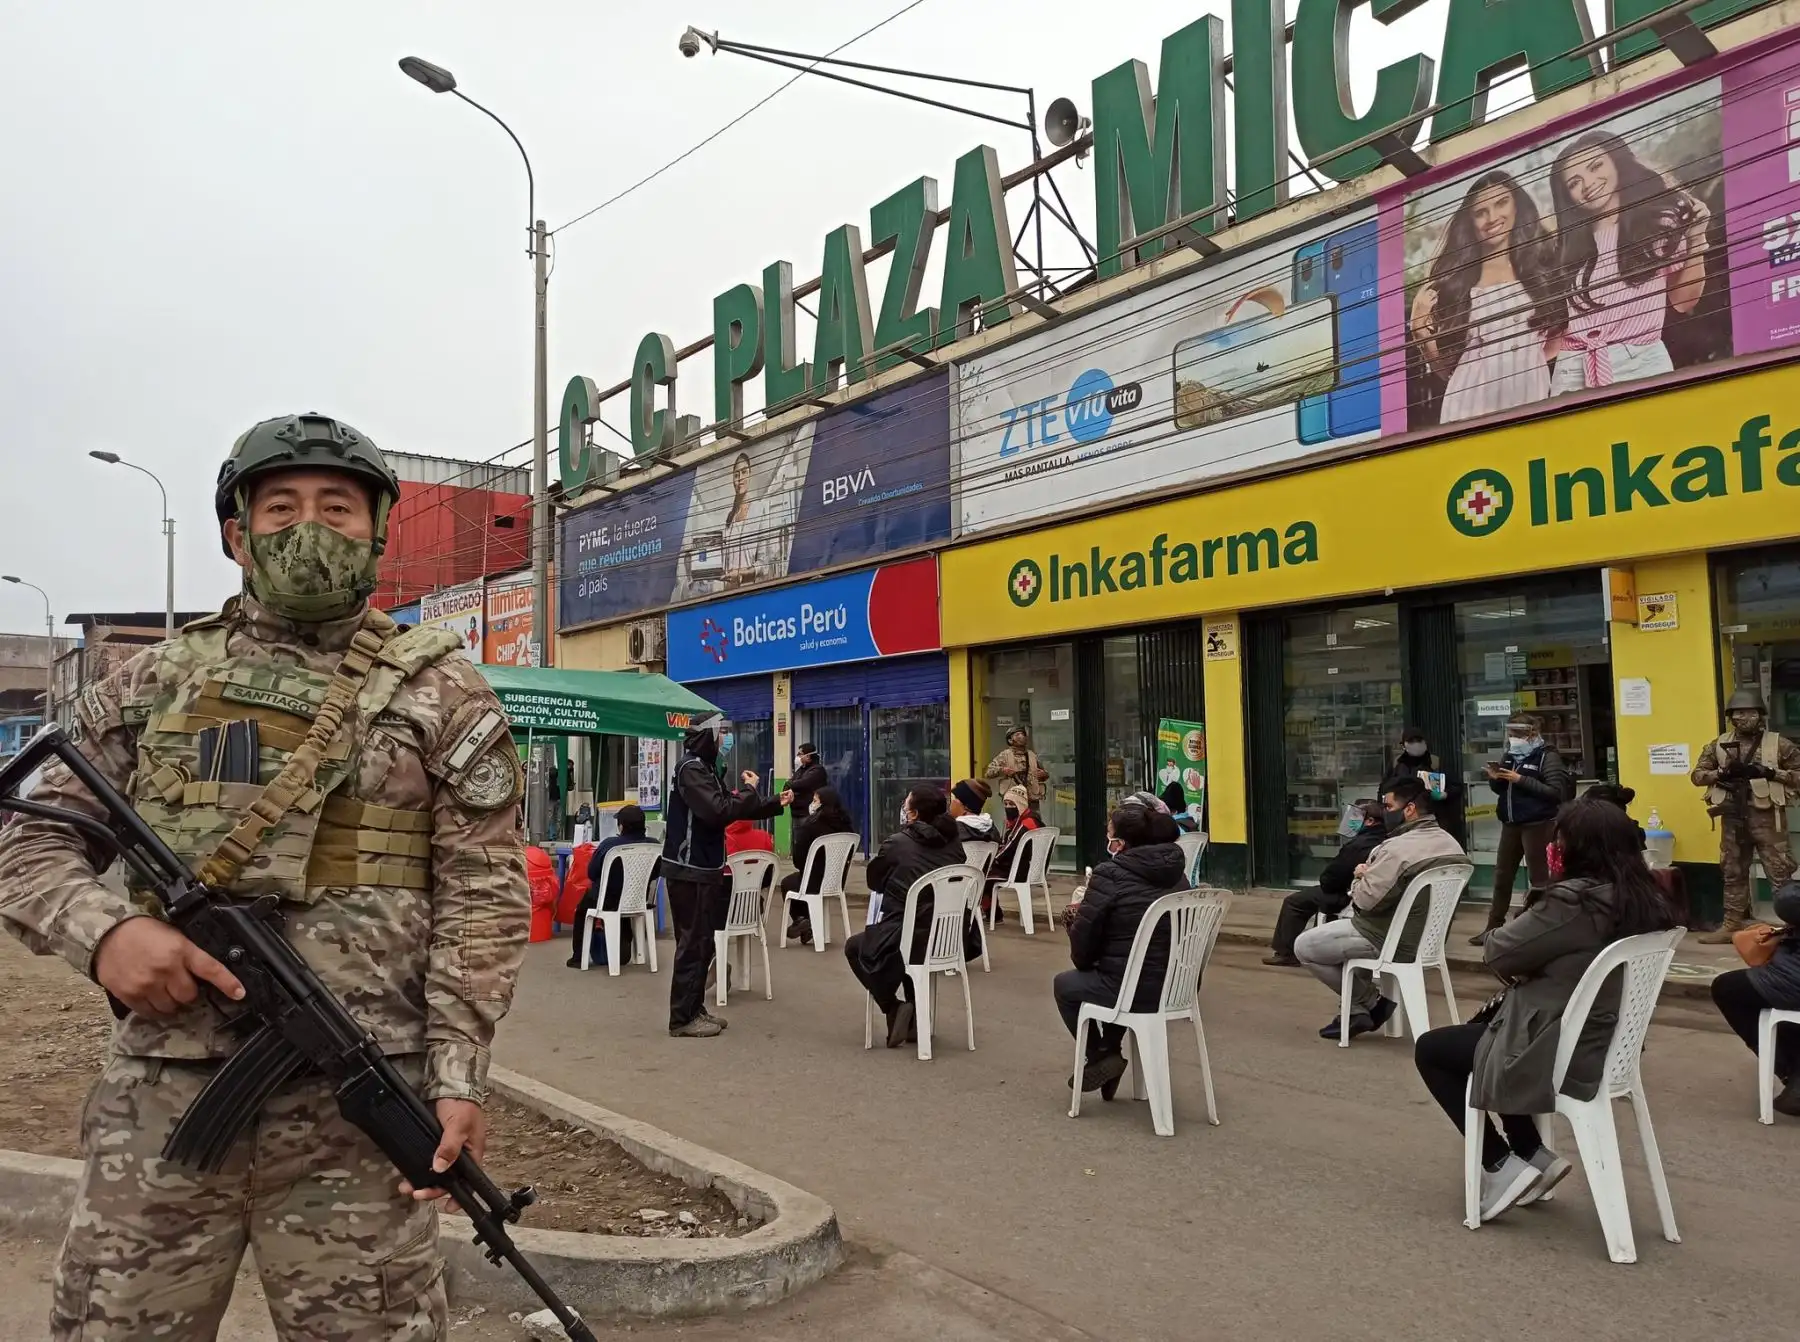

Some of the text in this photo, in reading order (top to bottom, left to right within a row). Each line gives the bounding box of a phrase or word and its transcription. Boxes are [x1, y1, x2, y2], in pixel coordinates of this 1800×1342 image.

[713, 144, 1025, 439] PLAZA
[1091, 0, 1775, 280] MIC
[1361, 287, 1375, 299] ZTE
[1000, 394, 1060, 457] ZTE
[1110, 388, 1137, 409] vita
[1025, 456, 1074, 477] PANTALLA,
[822, 464, 876, 505] BBVA
[579, 515, 657, 552] PYME, la fuerza
[578, 538, 662, 578] que revoluciona
[1049, 520, 1319, 603] Inkafarma
[578, 573, 608, 599] al país
[442, 591, 481, 615] MERCADO
[1640, 594, 1674, 603] VIGILADO
[733, 603, 847, 647] Boticas Perú
[1641, 621, 1676, 630] PROSEGUR
[496, 642, 516, 663] CHIP
[800, 639, 815, 651] salud
[233, 687, 310, 713] SANTIAGO
[504, 693, 588, 709] SUBGERENCIA DE
[500, 702, 600, 722] UCACIÓN, CULTURA,
[666, 711, 693, 729] VM
[511, 716, 598, 730] ORTE Y JUVENTUD
[467, 731, 483, 747] B+
